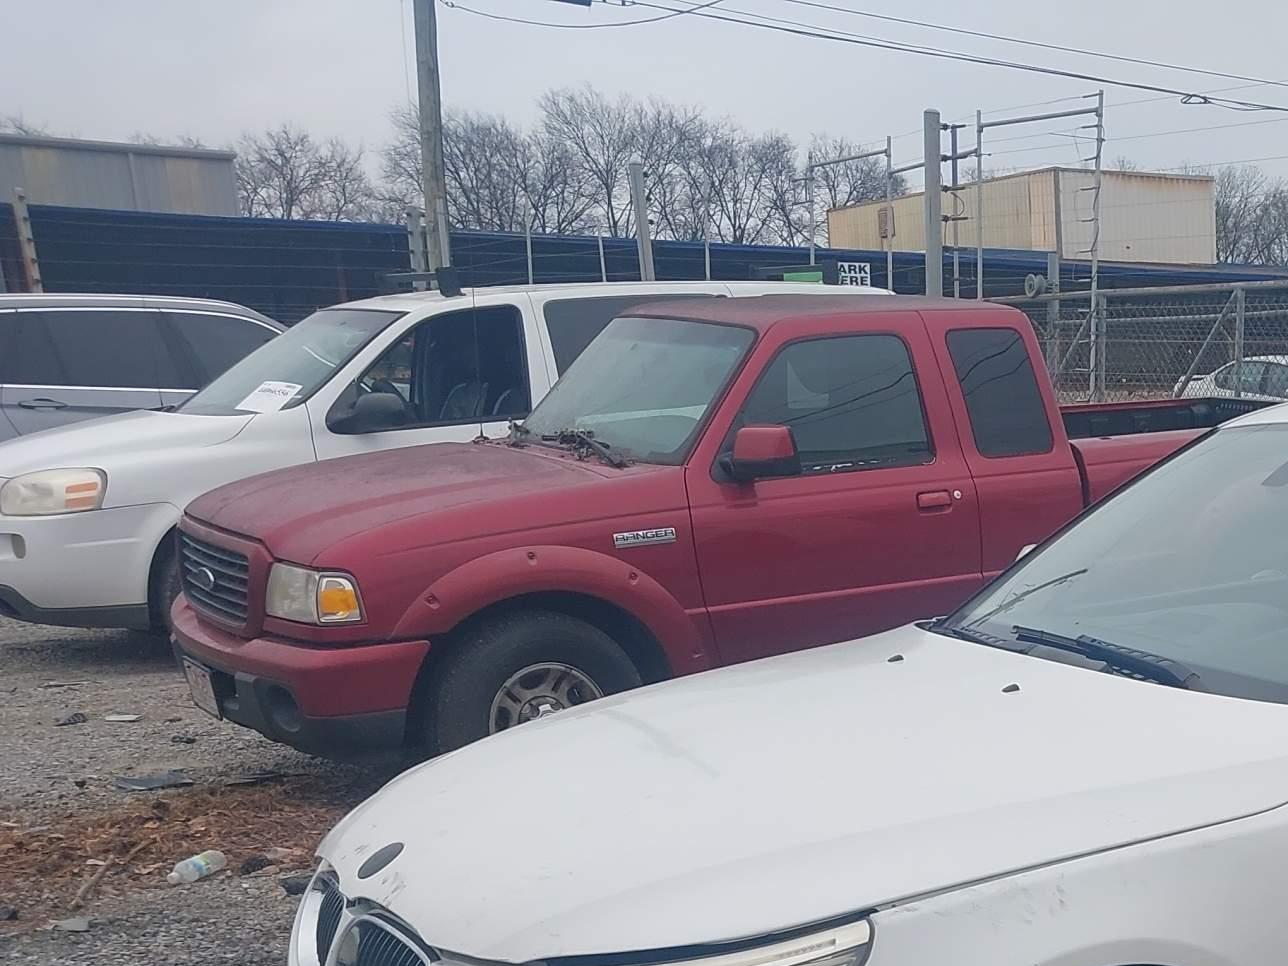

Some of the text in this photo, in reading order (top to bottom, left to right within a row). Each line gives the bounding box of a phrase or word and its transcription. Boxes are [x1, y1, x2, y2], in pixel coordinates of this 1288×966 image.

[838, 264, 868, 275] ARK
[840, 276, 868, 286] ERE
[615, 529, 675, 542] RANGER
